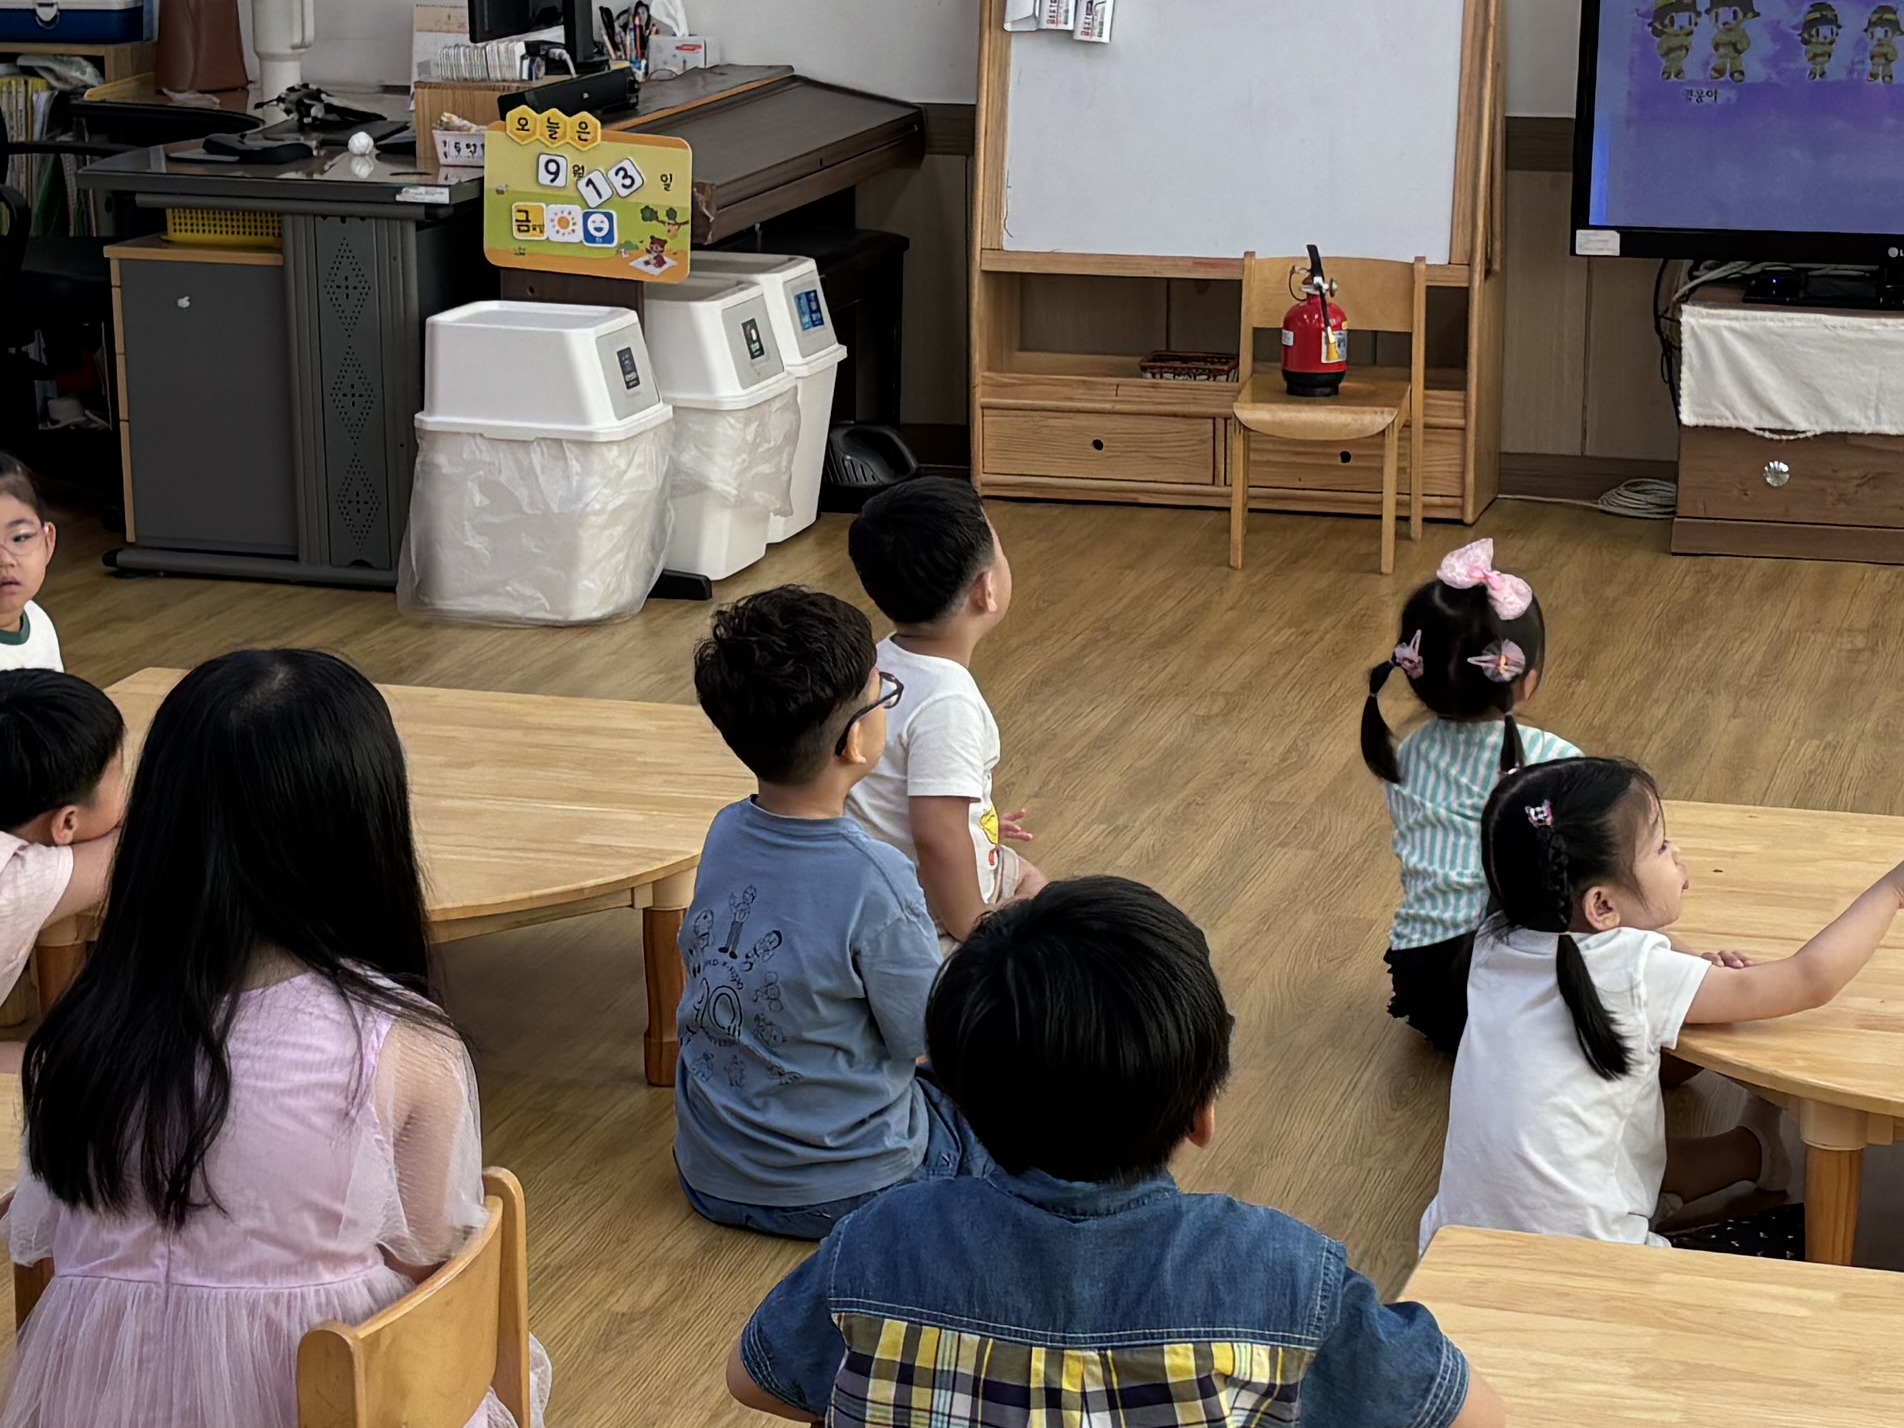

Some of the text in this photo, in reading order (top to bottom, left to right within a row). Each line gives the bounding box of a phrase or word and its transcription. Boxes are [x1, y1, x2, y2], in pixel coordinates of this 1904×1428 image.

[516, 116, 589, 142] 오늘은
[544, 158, 561, 183] 9
[660, 173, 673, 191] 일
[514, 208, 531, 234] 금
